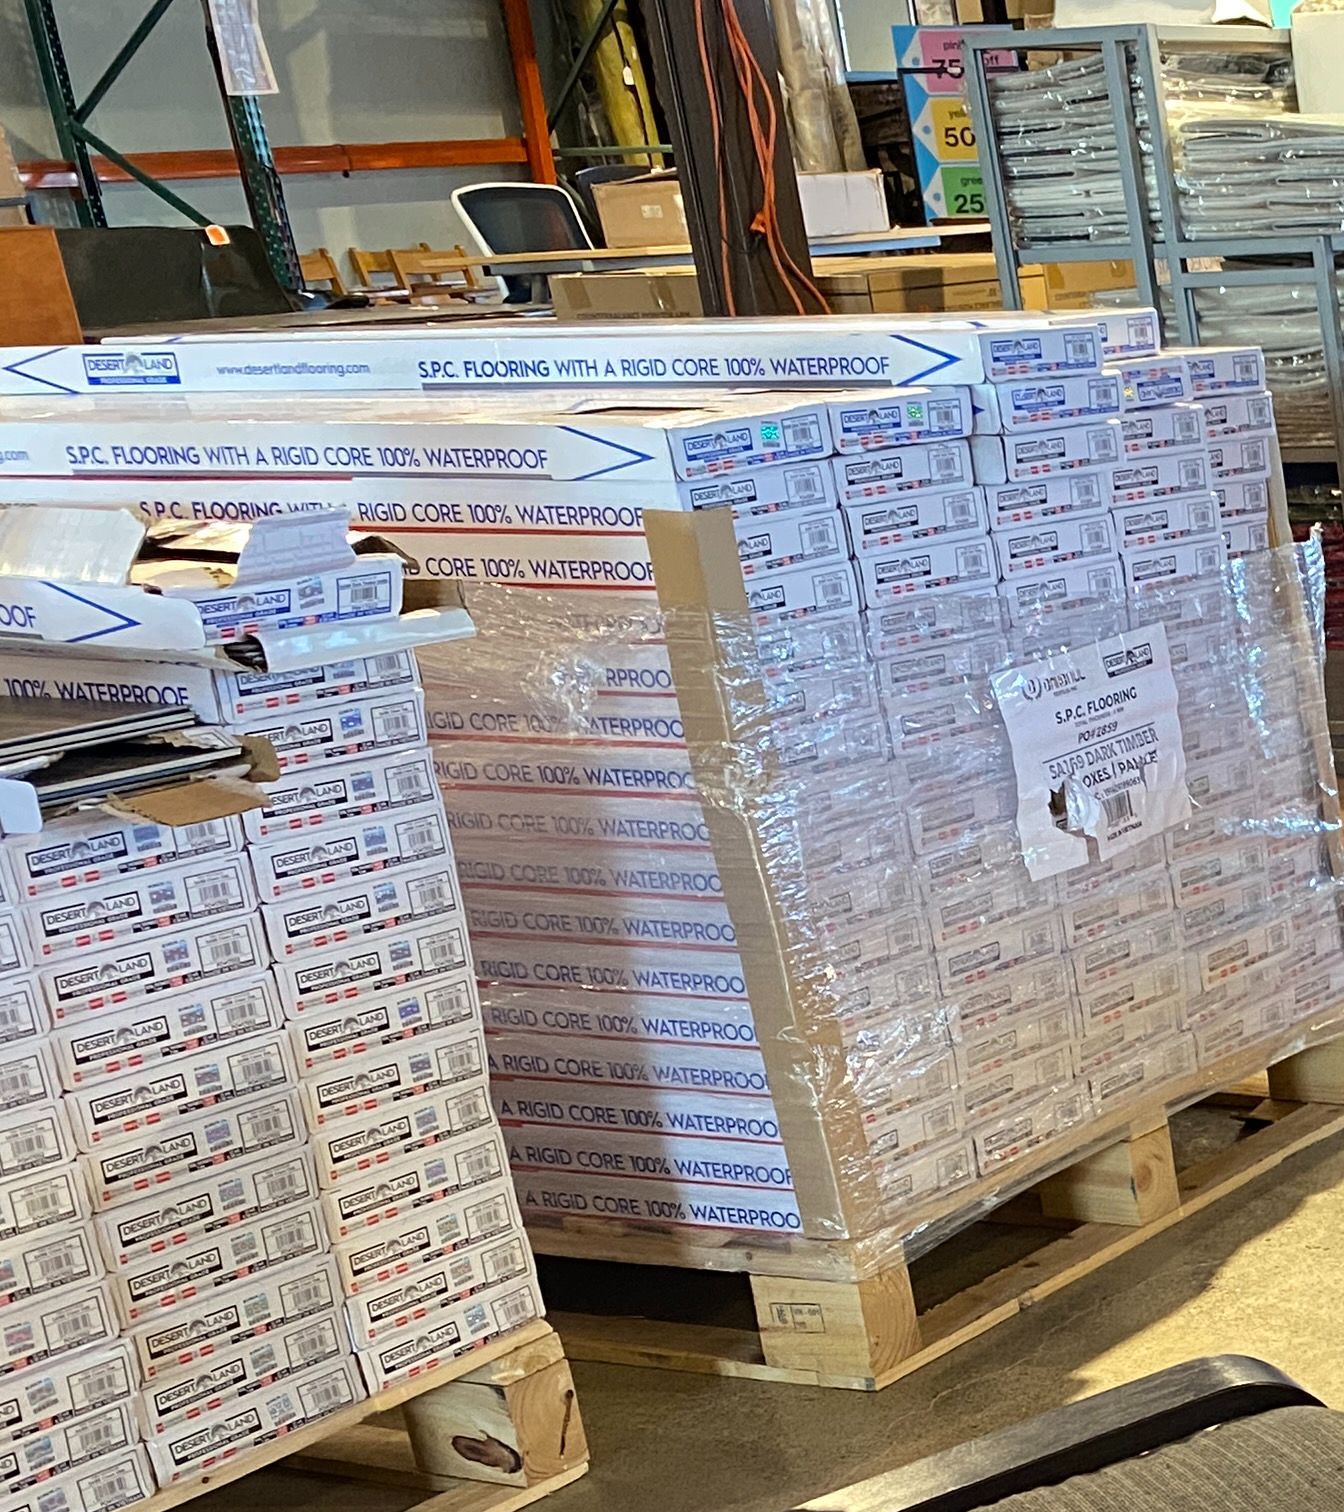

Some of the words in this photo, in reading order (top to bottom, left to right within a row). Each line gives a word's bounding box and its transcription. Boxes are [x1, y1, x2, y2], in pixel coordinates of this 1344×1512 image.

[961, 176, 982, 186] gree
[88, 358, 124, 372] DESERT
[144, 358, 173, 371] LAND
[419, 361, 459, 378] S.P.C.
[464, 360, 550, 378] FLOORING
[554, 360, 599, 377] WITH
[604, 360, 617, 377] A
[621, 358, 668, 377] RIGID
[672, 358, 720, 377] CORE
[724, 357, 766, 377] 100%
[772, 357, 891, 376] WATERPROOF
[687, 440, 714, 451] DESERT
[728, 432, 748, 444] LAND
[67, 446, 108, 465] S.P.C.
[112, 446, 199, 466] FLOORING
[207, 447, 249, 465] WITH
[256, 448, 269, 465] A
[273, 447, 318, 466] RIGID
[323, 447, 373, 466] CORE
[378, 447, 421, 468] 100%
[423, 448, 549, 470] WATERPROOF
[693, 489, 721, 502] DESERT
[734, 482, 753, 494] LAND
[358, 503, 406, 522] RIGID
[412, 504, 464, 523] CORE
[468, 505, 512, 524] 100%
[426, 557, 477, 577] CORE
[481, 559, 524, 579] 100%
[257, 593, 286, 604] LAND
[1055, 707, 1086, 724] S.P.C.
[1087, 687, 1138, 715] FLOORING
[303, 724, 328, 735] LAND
[484, 762, 532, 783] CORE
[538, 765, 580, 785] 100%
[583, 768, 695, 790] WATERPROO
[1082, 769, 1111, 788] OXES
[272, 792, 299, 805] ESERT
[316, 785, 342, 796] LAND
[31, 848, 71, 866] DESERT
[91, 837, 120, 850] LAND
[276, 854, 310, 868] DESERT
[327, 843, 353, 854] LAND
[46, 909, 86, 925] DESERT
[107, 897, 135, 911] LAND
[289, 912, 323, 926] DESERT
[339, 901, 365, 912] LAND
[523, 912, 571, 933] CORE
[574, 915, 618, 935] 100%
[622, 918, 736, 942] WATERPROO
[60, 971, 100, 989] DESERT
[119, 959, 148, 973] LAND
[300, 969, 334, 983] DESERT
[350, 958, 376, 969] LAND
[534, 963, 582, 983] CORE
[586, 966, 628, 986] 100%
[632, 968, 745, 994] WATERPROO
[309, 1025, 343, 1041] DESERT
[359, 1012, 384, 1025] LAND
[543, 1010, 592, 1031] CORE
[597, 1014, 638, 1034] 100%
[76, 1035, 116, 1053] DESERT
[135, 1022, 164, 1035] LAND
[503, 1055, 549, 1074] RIGID
[554, 1058, 602, 1078] CORE
[606, 1061, 648, 1081] 100%
[95, 1094, 134, 1113] DESERT
[152, 1080, 180, 1094] LAND
[321, 1081, 355, 1097] DESERT
[370, 1069, 395, 1081] LAND
[501, 1099, 513, 1115] A
[517, 1101, 564, 1120] RIGID
[569, 1104, 617, 1125] CORE
[621, 1108, 663, 1128] 100%
[666, 1112, 778, 1138] WATERPROO
[333, 1136, 367, 1153] DESERT
[382, 1122, 406, 1134] LAND
[106, 1154, 144, 1172] DESERT
[163, 1138, 191, 1152] LAND
[510, 1145, 523, 1162] A
[526, 1146, 572, 1166] RIGID
[577, 1151, 625, 1170] CORE
[628, 1155, 670, 1175] 100%
[343, 1192, 376, 1209] DESERT
[390, 1177, 415, 1189] LAND
[123, 1216, 161, 1234] DESERT
[179, 1200, 207, 1215] LAND
[526, 1191, 539, 1206] A
[543, 1192, 587, 1211] RIGID
[592, 1197, 640, 1216] CORE
[644, 1201, 686, 1220] 100%
[690, 1205, 800, 1228] WATERPROO
[354, 1247, 387, 1265] DESERT
[401, 1231, 425, 1245] LAND
[133, 1271, 170, 1290] DESERT
[189, 1254, 216, 1269] LAND
[372, 1293, 404, 1312] DESERT
[418, 1277, 443, 1292] LAND
[151, 1329, 188, 1347] DESERT
[206, 1312, 234, 1327] LAND
[384, 1344, 415, 1363] DESERT
[431, 1327, 454, 1342] LAND
[159, 1384, 197, 1403] DESERT
[212, 1365, 240, 1381] LAND
[175, 1435, 211, 1454] DESERT
[228, 1415, 254, 1432] LAND
